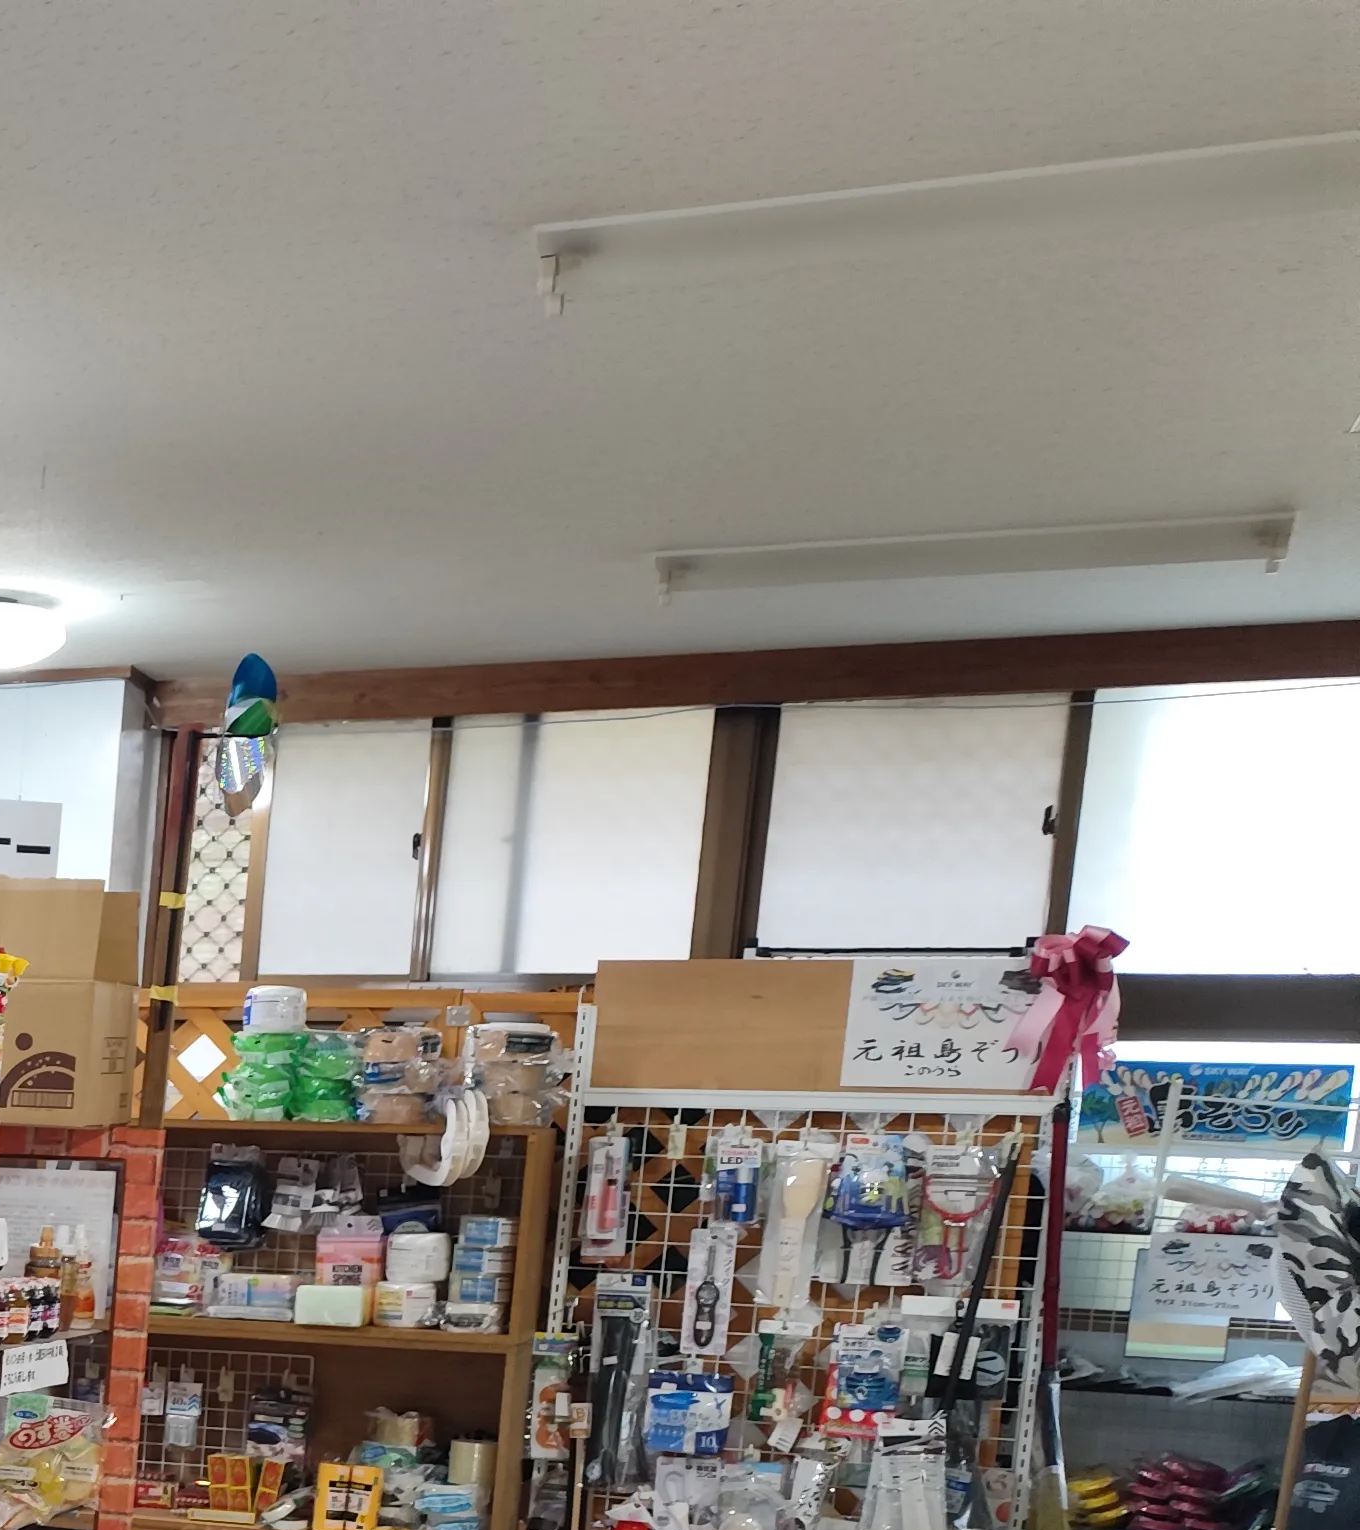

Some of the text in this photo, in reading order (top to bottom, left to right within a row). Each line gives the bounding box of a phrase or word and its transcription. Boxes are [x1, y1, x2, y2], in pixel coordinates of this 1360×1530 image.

[720, 1156, 745, 1166] LED
[1147, 1277, 1275, 1300] 元祖島ぞうり
